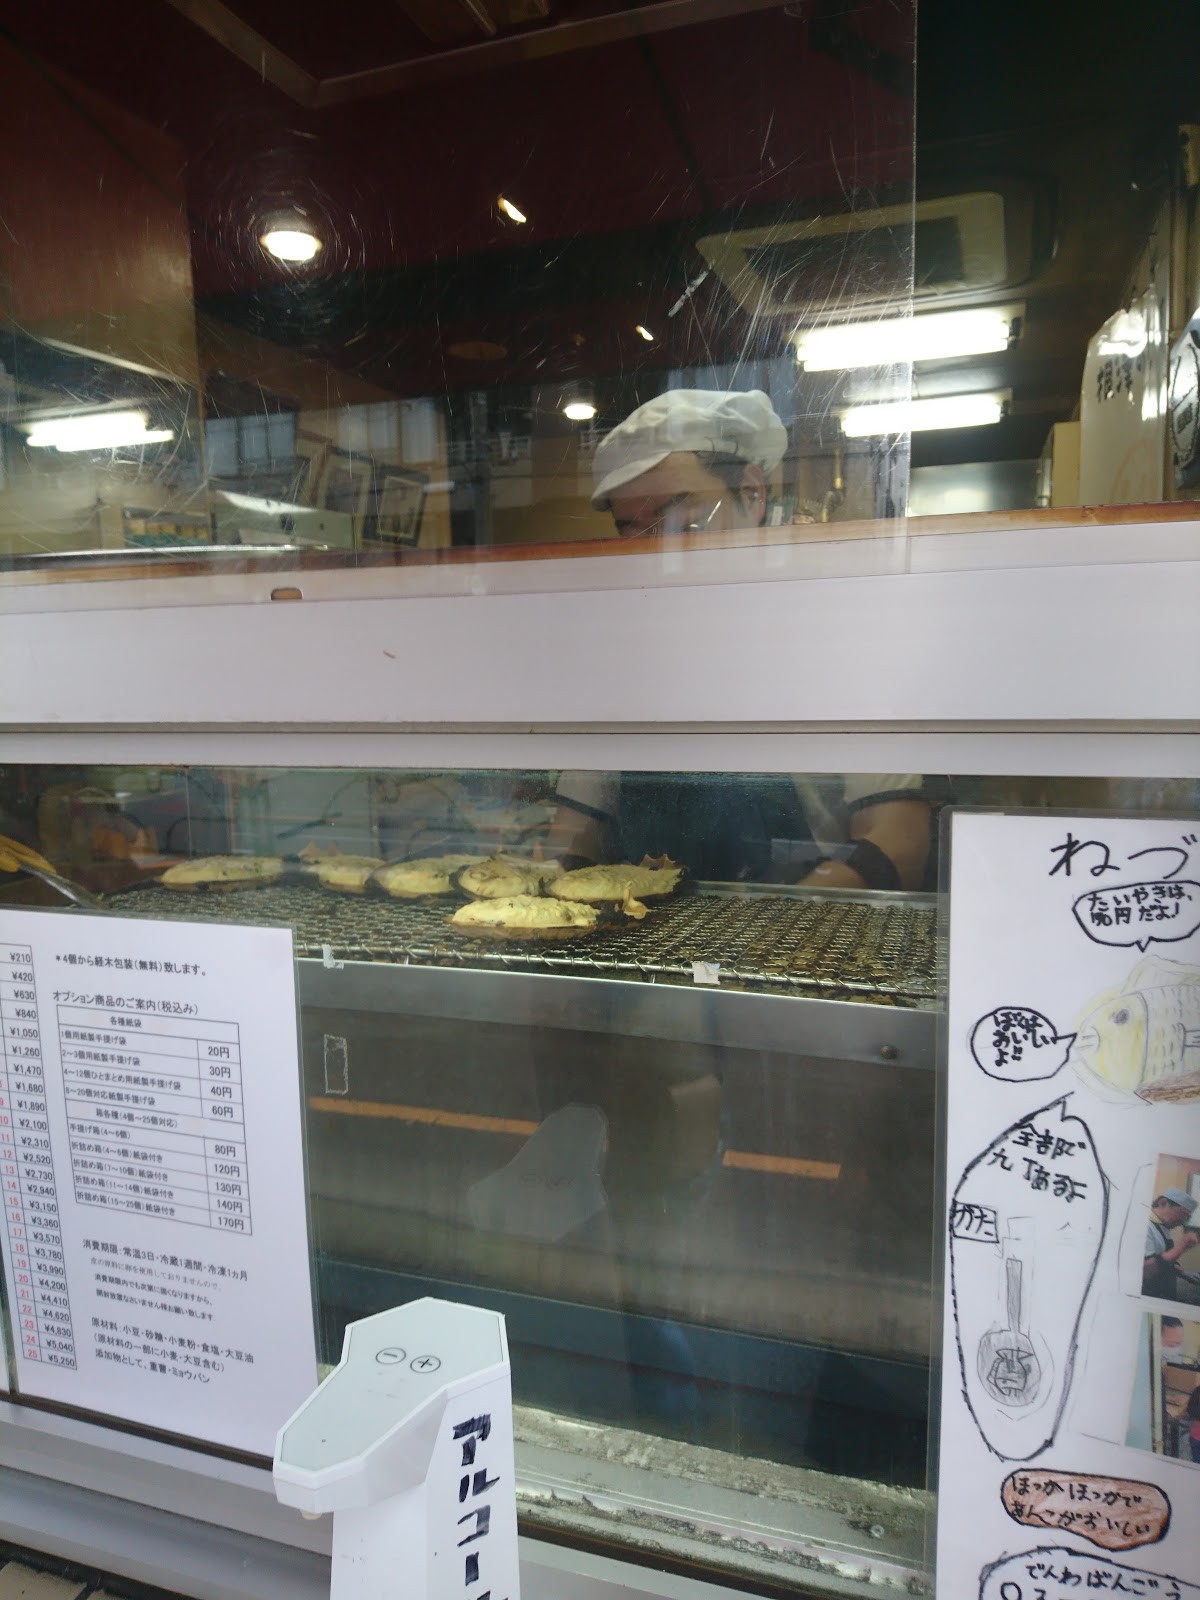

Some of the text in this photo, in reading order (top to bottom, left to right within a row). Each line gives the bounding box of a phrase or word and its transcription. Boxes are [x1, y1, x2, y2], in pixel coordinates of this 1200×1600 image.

[1049, 833, 1198, 879] ねづ
[10, 952, 31, 963] ¥210
[12, 971, 33, 982] ¥420
[14, 989, 35, 1000] ¥630
[15, 1008, 36, 1019] ¥840
[109, 1016, 142, 1028] 各種紙袋
[10, 1026, 39, 1039] ¥1,050
[12, 1045, 40, 1057] ¥1,260
[208, 1047, 230, 1059] 20円
[14, 1064, 42, 1076] ¥1,470
[209, 1066, 231, 1079] 30円
[15, 1081, 44, 1094] ¥1,680
[210, 1086, 232, 1098] 40円
[17, 1099, 45, 1112] ¥1,890
[212, 1105, 233, 1118] 60円
[19, 1118, 47, 1130] ¥2,100
[1, 1133, 49, 1149] 11 ¥2,310
[3, 1150, 51, 1165] 12 ¥2,520
[215, 1145, 236, 1157] 80円
[5, 1166, 53, 1181] 13 ¥2,730
[214, 1164, 240, 1177] 120円
[7, 1181, 55, 1197] 14 ¥2,940
[215, 1182, 242, 1195] 130円
[9, 1197, 57, 1213] 15 ¥3,150
[217, 1200, 243, 1213] 140円
[11, 1213, 59, 1229] 16 ¥3,360
[218, 1216, 244, 1230] 170円
[13, 1228, 61, 1245] 17 ¥3,570
[15, 1243, 62, 1260] 18 ¥3,780
[17, 1259, 64, 1276] 19 ¥3,990
[18, 1274, 66, 1291] 20 ¥4,200
[20, 1289, 68, 1307] 21 ¥4,410
[22, 1304, 70, 1322] 22 ¥4,620
[24, 1319, 72, 1338] 23 ¥4,830
[26, 1334, 73, 1353] 24 ¥5,040
[27, 1349, 75, 1368] 25 ¥5,250
[453, 1414, 508, 1600] アルコー
